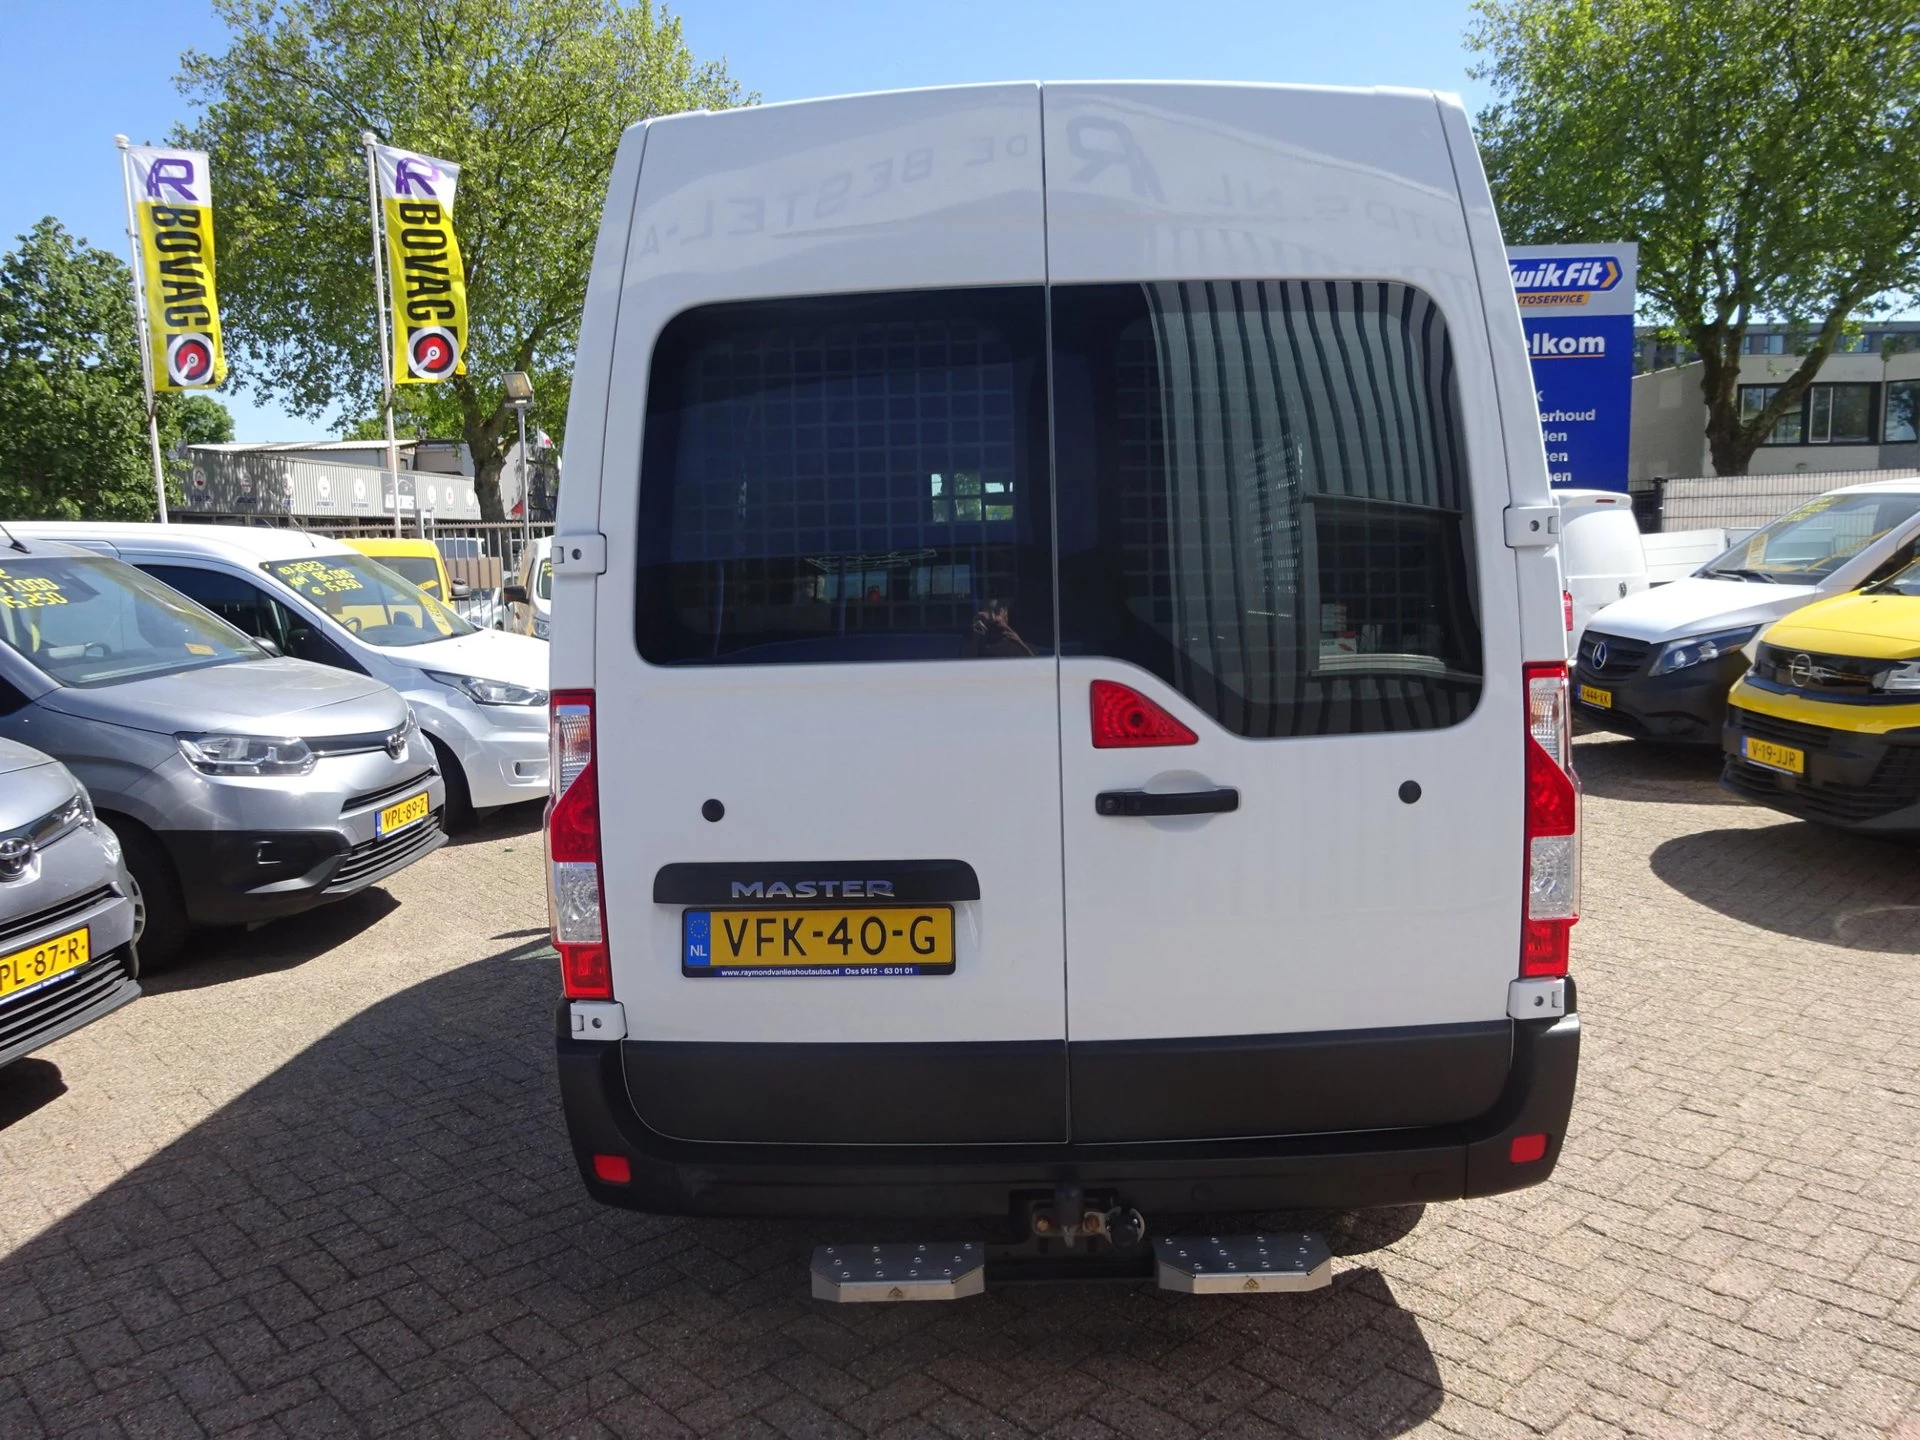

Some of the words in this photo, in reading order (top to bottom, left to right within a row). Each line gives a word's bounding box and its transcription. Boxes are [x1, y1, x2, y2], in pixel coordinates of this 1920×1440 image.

[151, 205, 211, 328] BOVAG
[399, 203, 455, 322] BOVAG
[1752, 741, 1797, 769] V-19-JJR
[384, 797, 425, 828] VPL-89-Z
[731, 879, 895, 899] MASTER
[723, 915, 936, 957] VFK-40-G
[690, 945, 708, 957] NL
[721, 967, 840, 977] www.raymondvanlieshoutautos.nl
[860, 967, 877, 975] 0412
